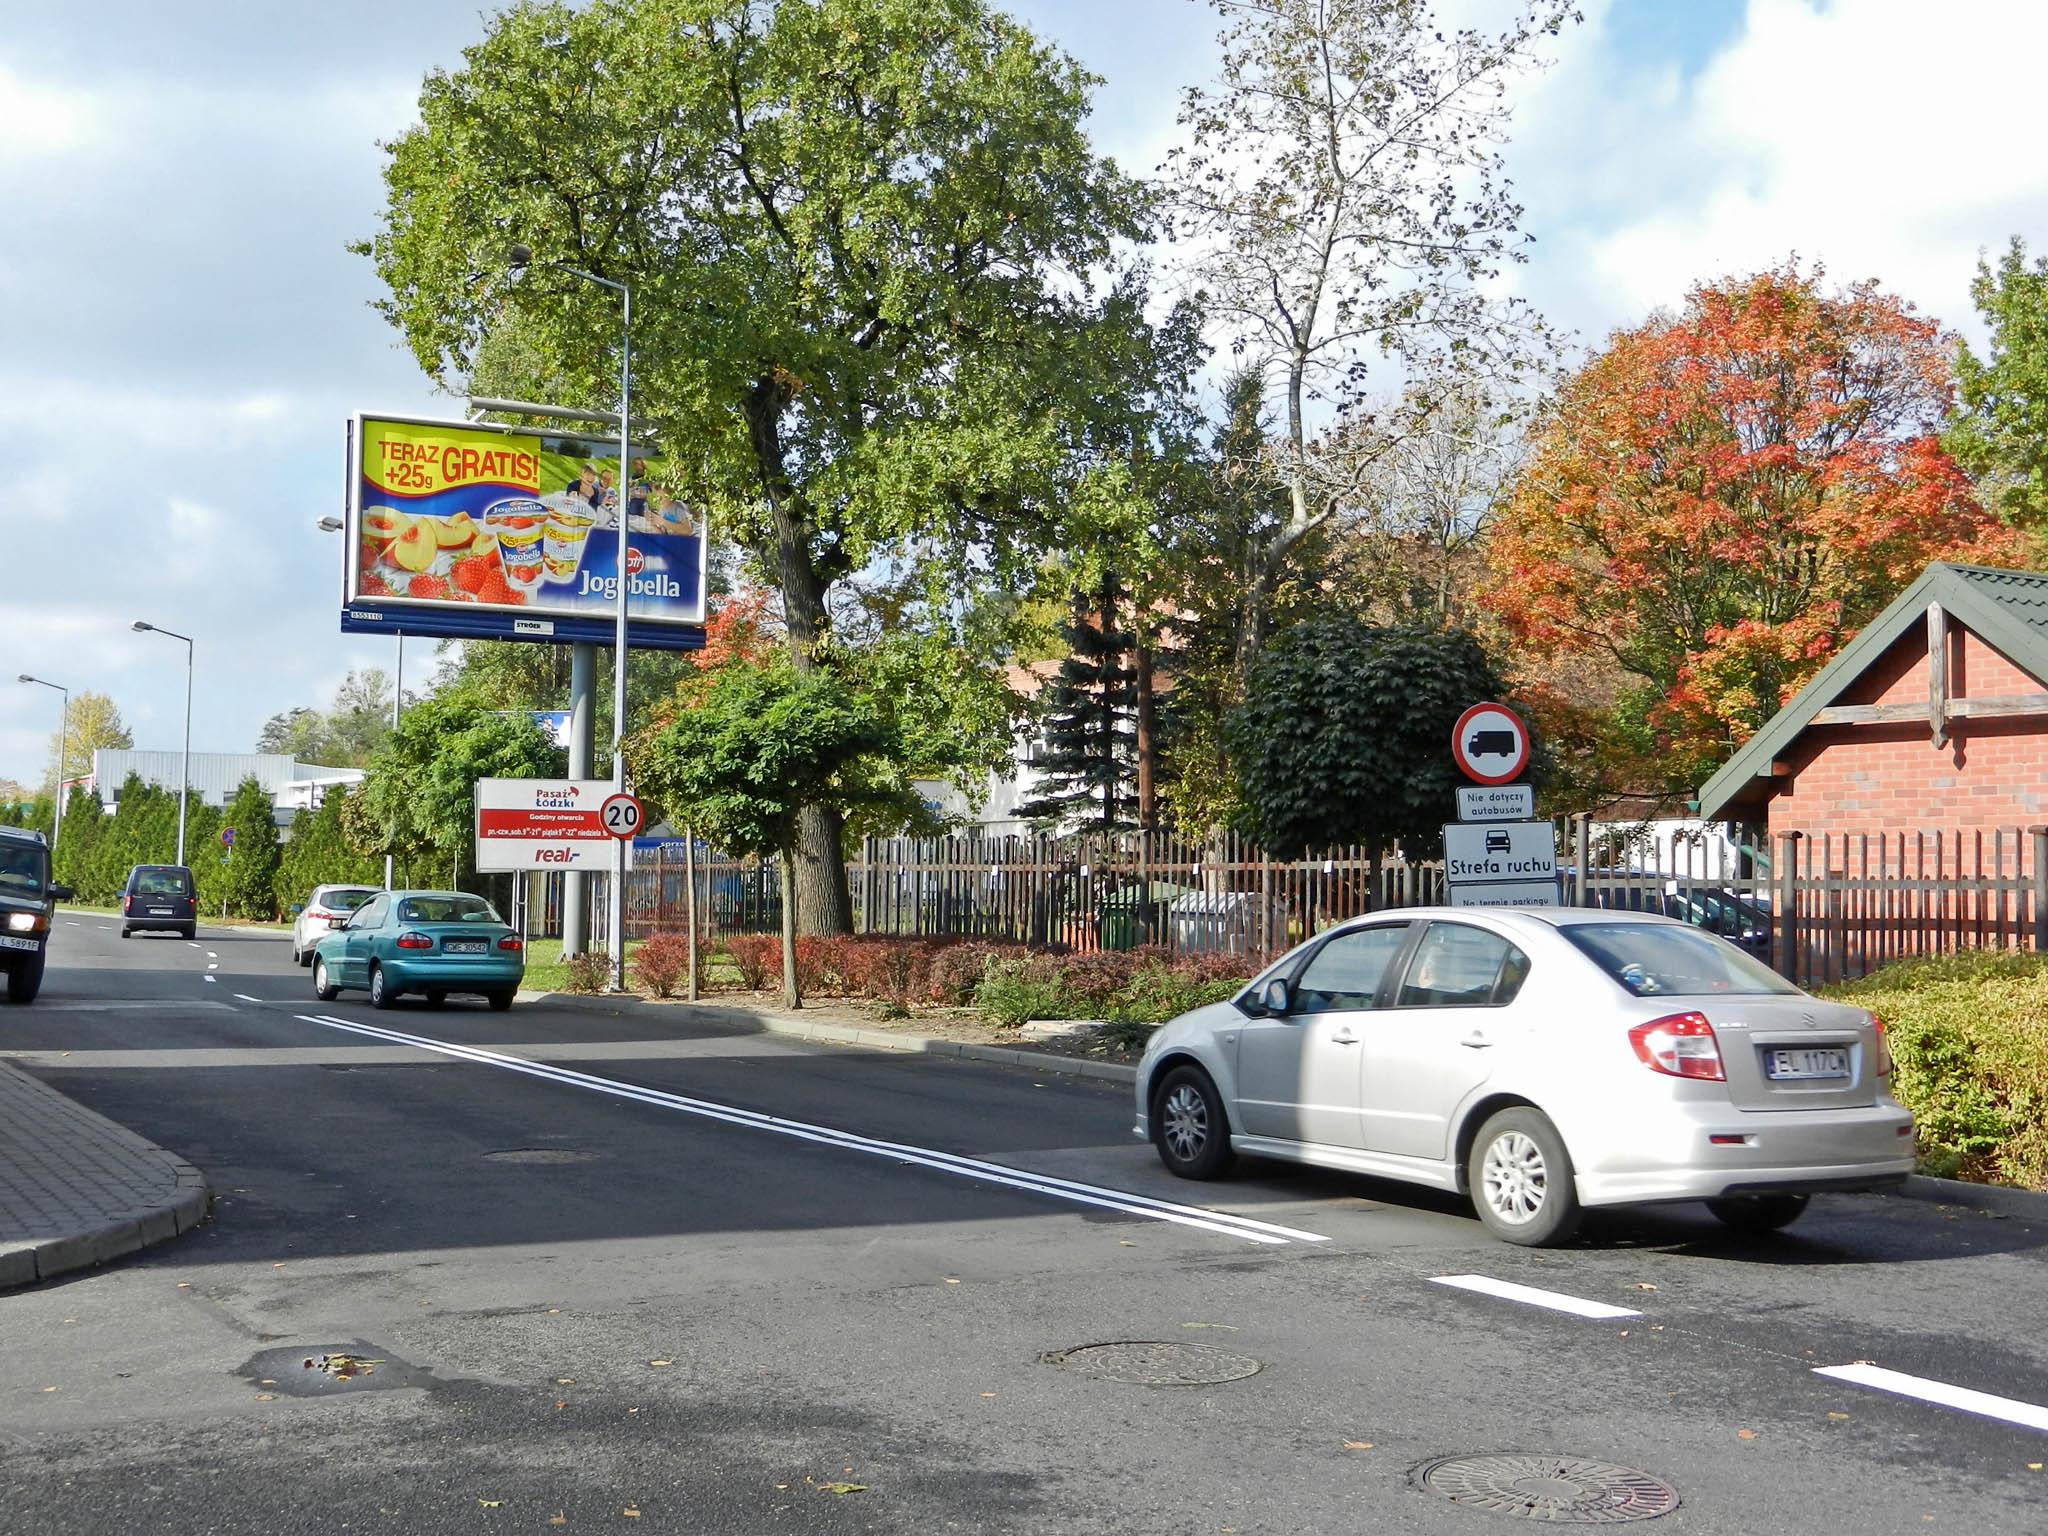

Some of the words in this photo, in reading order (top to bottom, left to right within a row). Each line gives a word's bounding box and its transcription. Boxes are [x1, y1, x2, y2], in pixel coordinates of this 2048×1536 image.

[378, 440, 440, 464] TERAZ
[441, 447, 539, 483] GRATIS!
[385, 463, 433, 489] +25g
[578, 569, 681, 600] Jogbella
[536, 789, 568, 798] Pasaż
[1467, 793, 1484, 802] Nie
[1488, 792, 1524, 803] dotyczy
[536, 798, 574, 808] Łódzki
[529, 813, 556, 822] Godziny
[608, 805, 638, 826] 20
[1471, 806, 1522, 816] autobusów
[1451, 858, 1500, 875] Strefa
[1507, 857, 1551, 873] ruchu
[1512, 896, 1549, 906] parkingu
